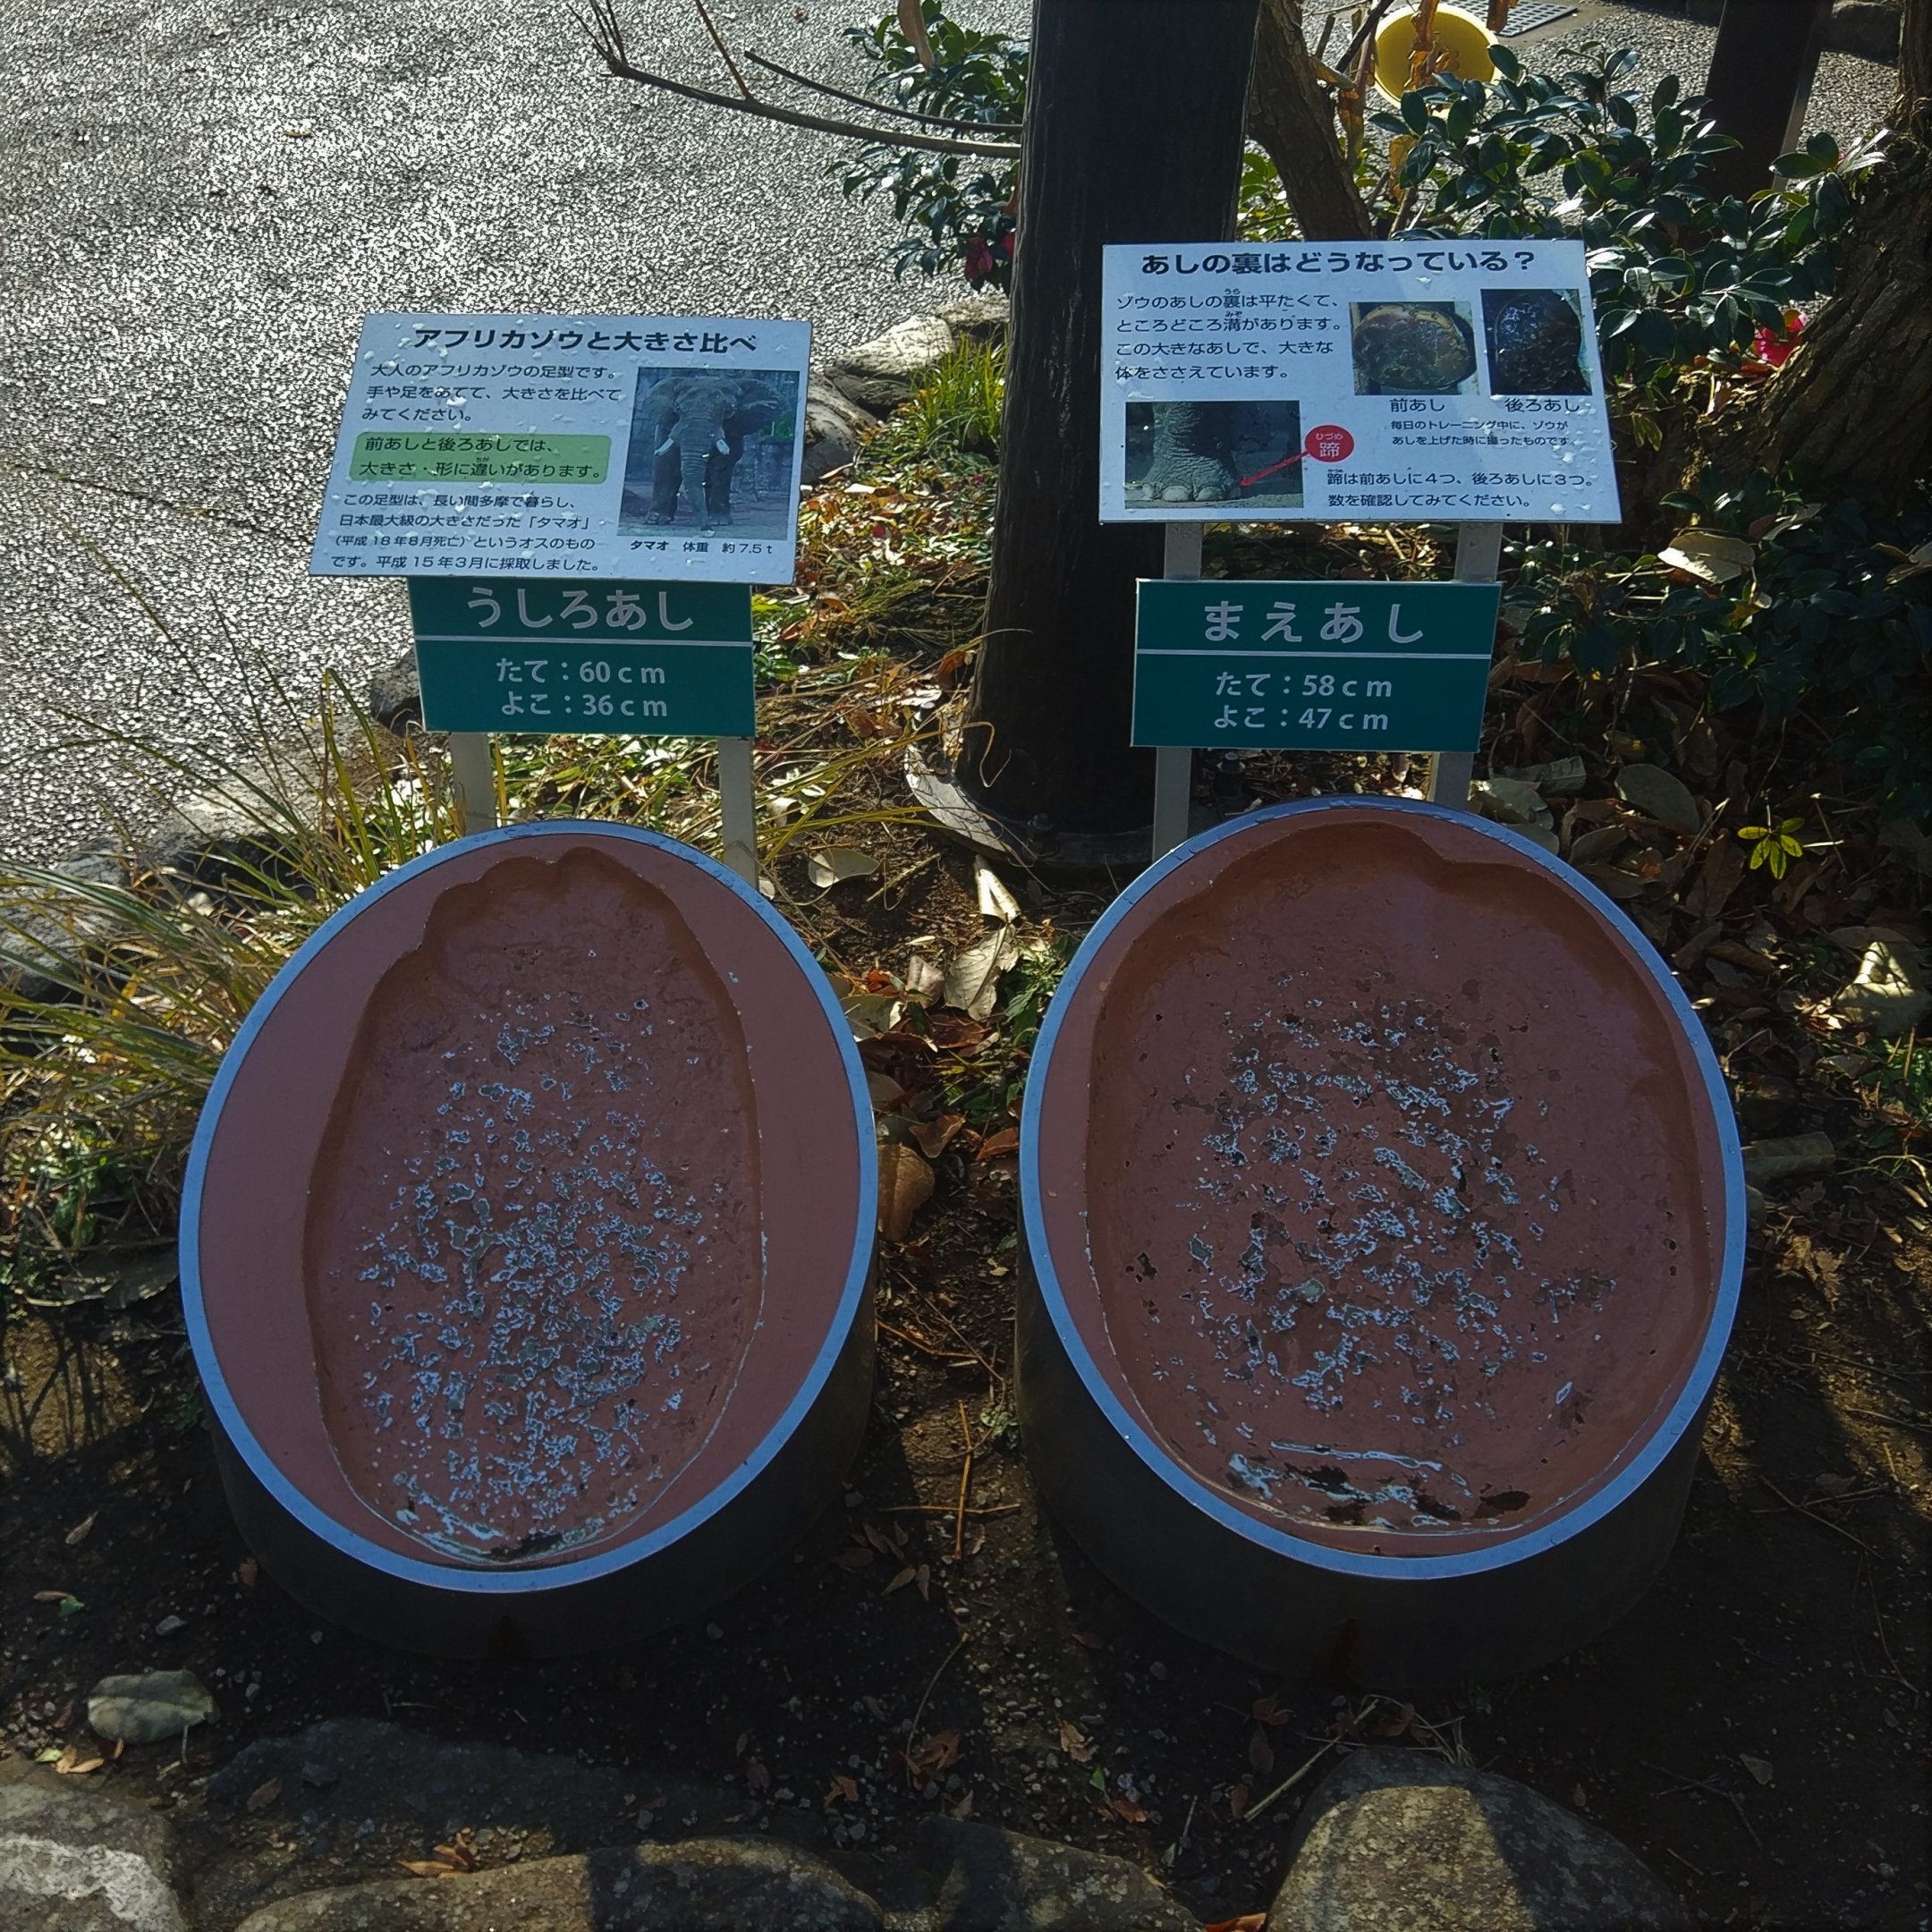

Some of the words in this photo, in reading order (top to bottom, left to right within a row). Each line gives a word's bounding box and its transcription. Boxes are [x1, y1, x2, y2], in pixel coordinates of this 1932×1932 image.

[1141, 251, 1535, 275] あしの裏はどうなっている？
[1116, 294, 1341, 309] ゾウのあしの裏は平たくて、
[1116, 318, 1341, 332] ところどころ溝があります。
[414, 328, 758, 353] アフリカゾウと大きさ比べ
[1116, 341, 1334, 355] この大きなあしで、大きな
[370, 364, 615, 379] 大人のアフリカゾウの足型です。
[1114, 365, 1288, 379] 体をささえています。
[366, 386, 623, 402] 手や足をあてて、大きさを比べて
[1389, 398, 1445, 413] 前あし
[1504, 398, 1581, 413] 後ろあし
[361, 408, 471, 422] みてください。
[1315, 432, 1343, 441] ひづめ
[365, 436, 552, 453] 前あしと後ろあしでは、
[1319, 441, 1340, 458] 蹄
[1327, 494, 1530, 507] 数を確認してみてください。
[630, 539, 669, 551] タマオ
[682, 540, 709, 553] 体重
[468, 587, 694, 631] うしろあし
[1204, 600, 1424, 644] まえあし
